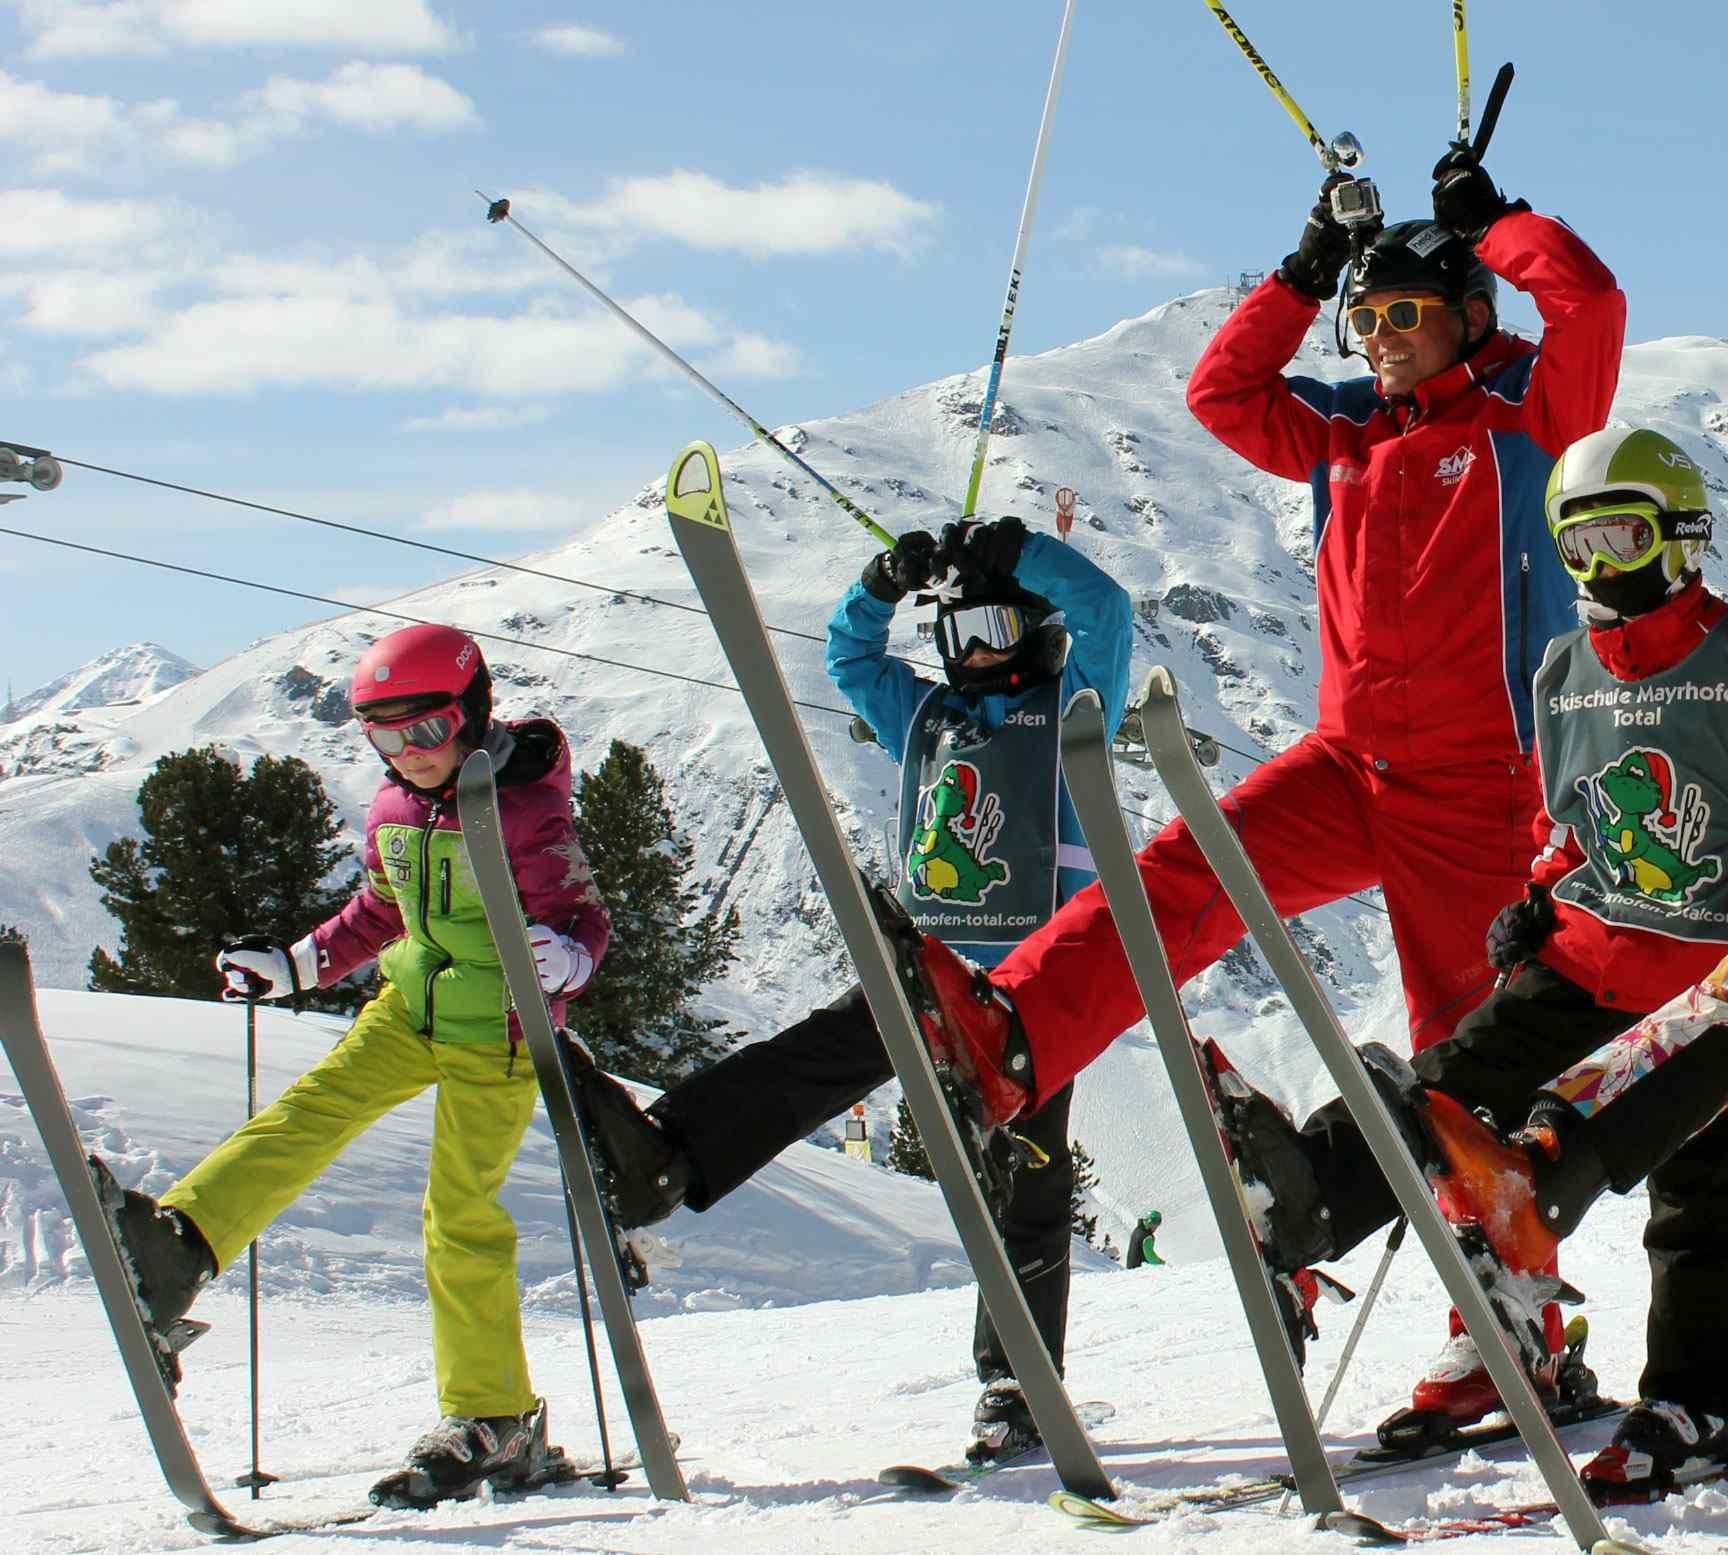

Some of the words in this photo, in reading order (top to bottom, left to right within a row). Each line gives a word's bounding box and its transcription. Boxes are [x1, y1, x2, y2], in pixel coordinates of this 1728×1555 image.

[1211, 8, 1282, 89] ATOMIC
[1005, 268, 1021, 315] LEKI
[1549, 687, 1632, 715] Skischule
[1613, 706, 1662, 727] Total
